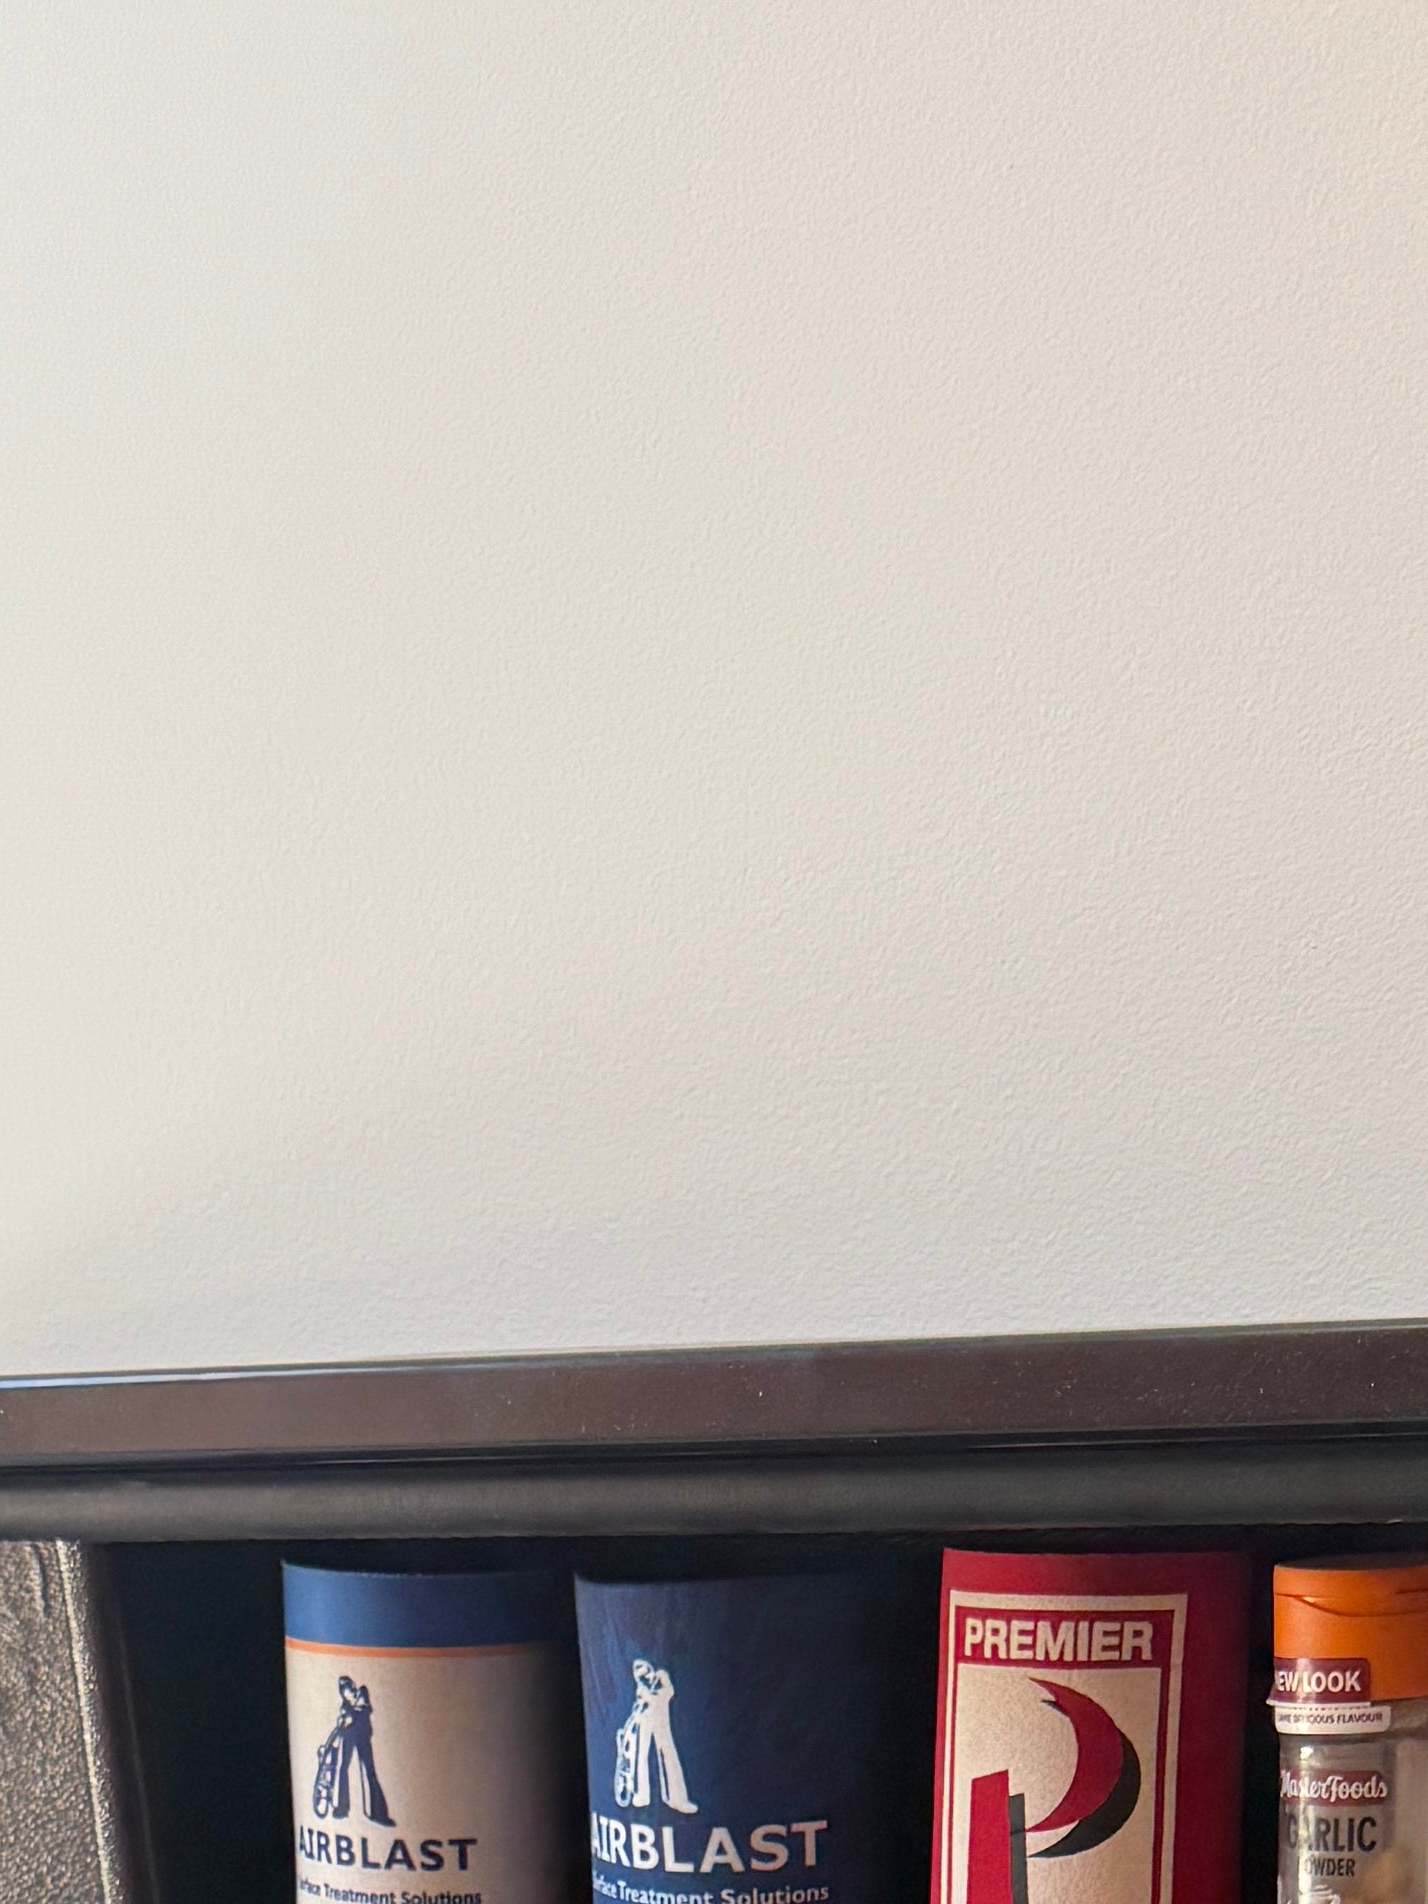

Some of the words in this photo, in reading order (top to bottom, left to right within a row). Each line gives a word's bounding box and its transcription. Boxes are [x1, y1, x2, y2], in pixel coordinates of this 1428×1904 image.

[964, 1617, 1153, 1662] PREMIER
[1276, 1670, 1299, 1691] EW
[1302, 1670, 1361, 1693] LOOK
[1336, 1713, 1383, 1724] FLAVOUR
[1280, 1770, 1388, 1802] MasterFoods
[300, 1825, 477, 1871] AIRBLAST
[591, 1812, 828, 1873] AIRBLAST
[1288, 1816, 1378, 1852] GRLIC
[1304, 1856, 1355, 1877] OWDER
[299, 1876, 321, 1897] rface
